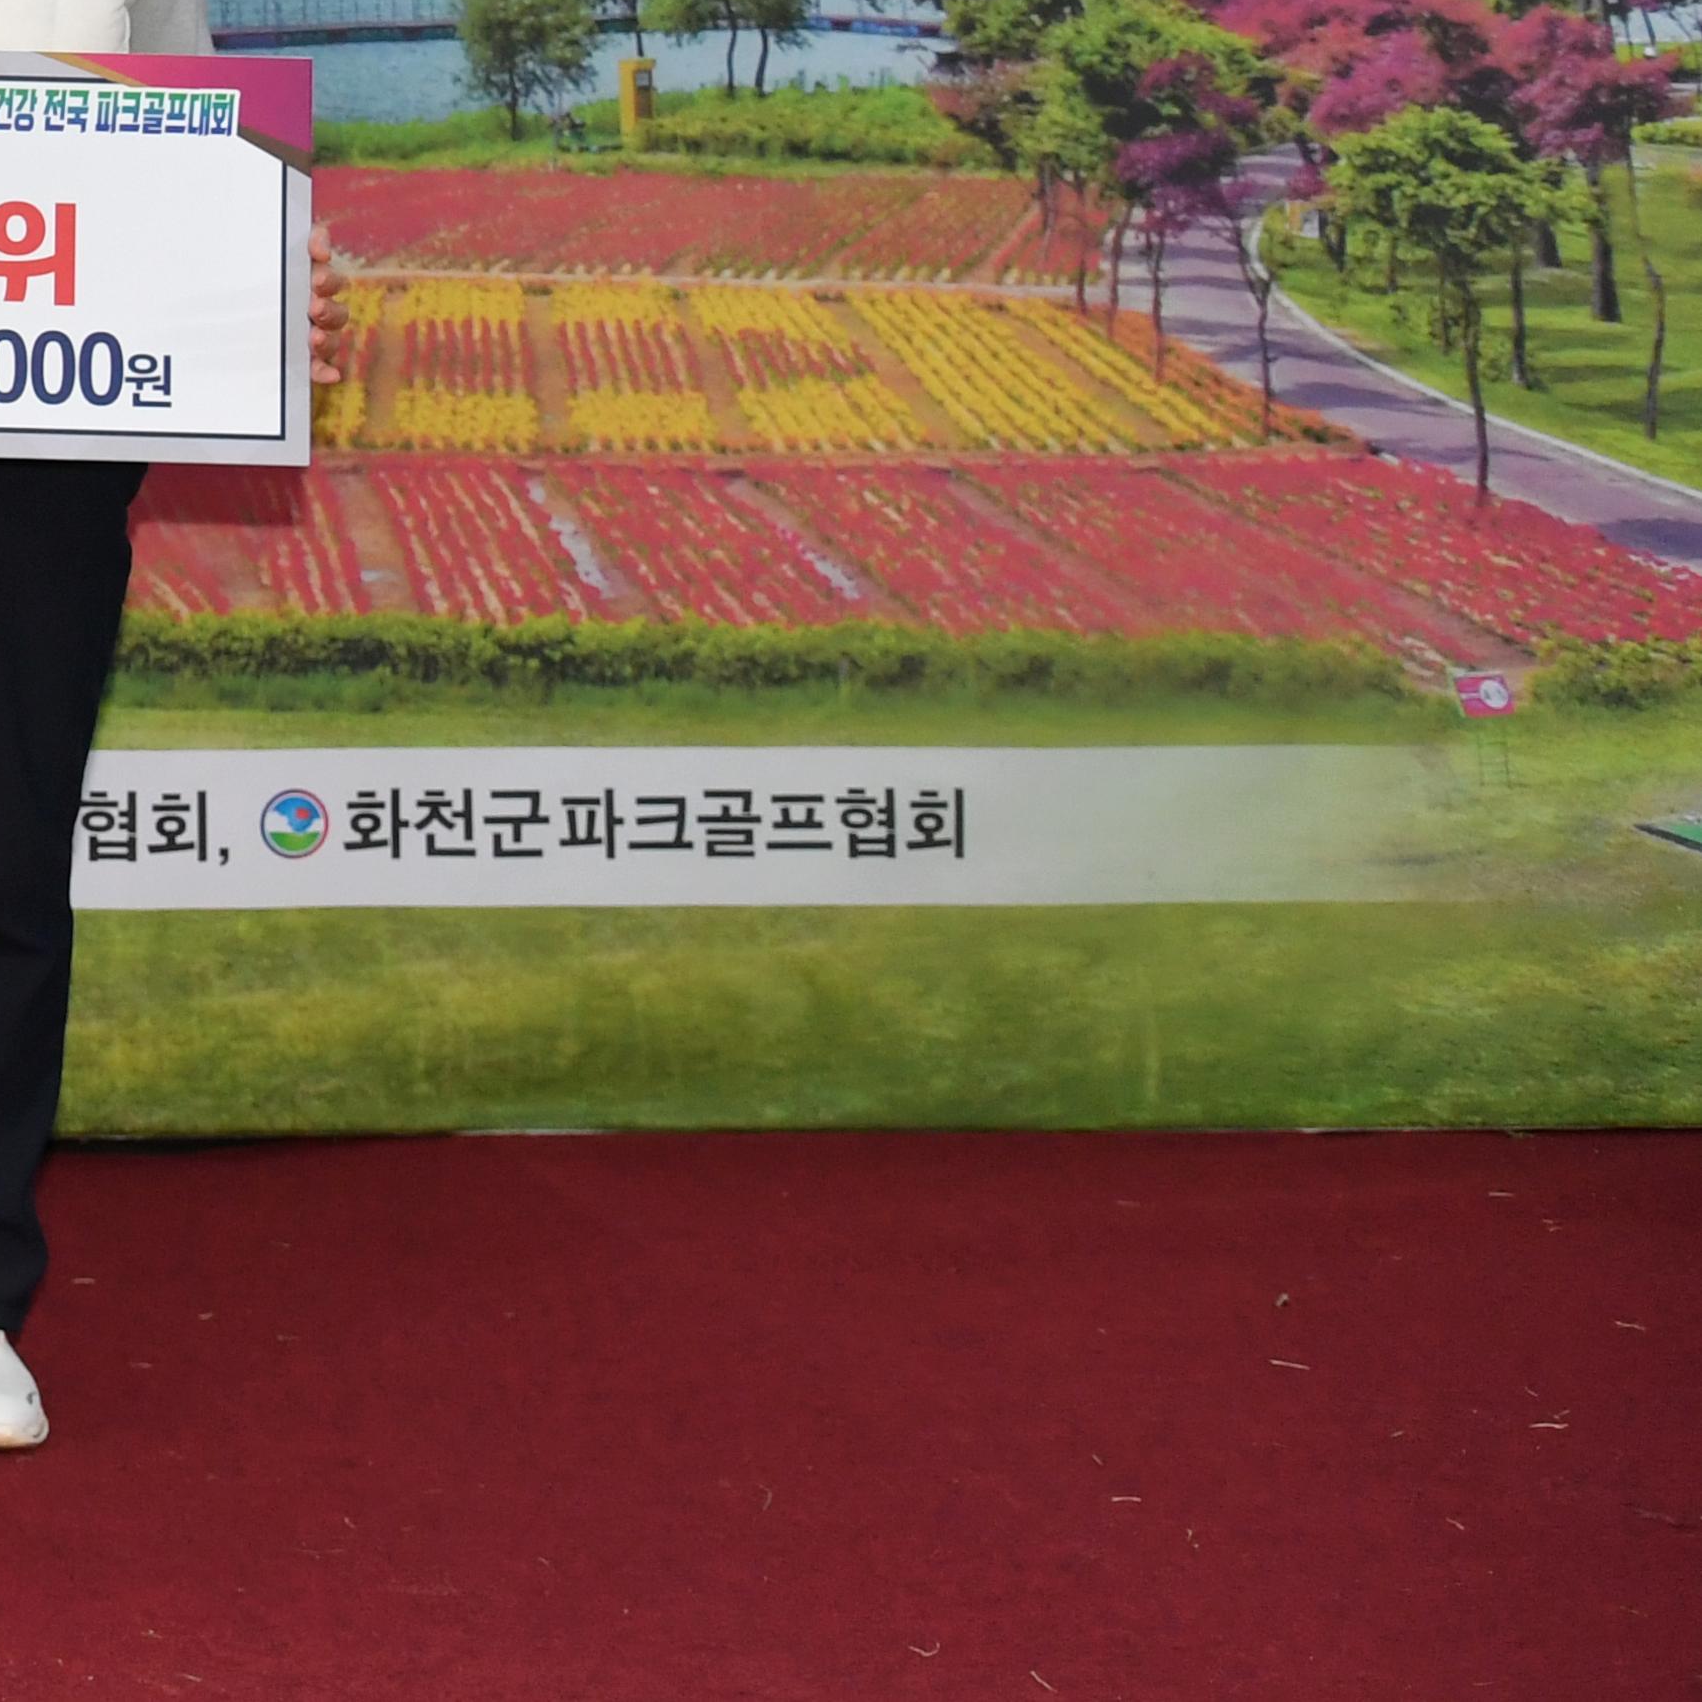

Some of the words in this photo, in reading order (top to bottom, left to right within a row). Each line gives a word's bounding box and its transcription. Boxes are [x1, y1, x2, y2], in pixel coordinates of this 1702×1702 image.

[43, 89, 90, 134] 전국
[96, 90, 236, 137] 파크골프대회
[342, 786, 967, 860] 화천군파크골프협회
